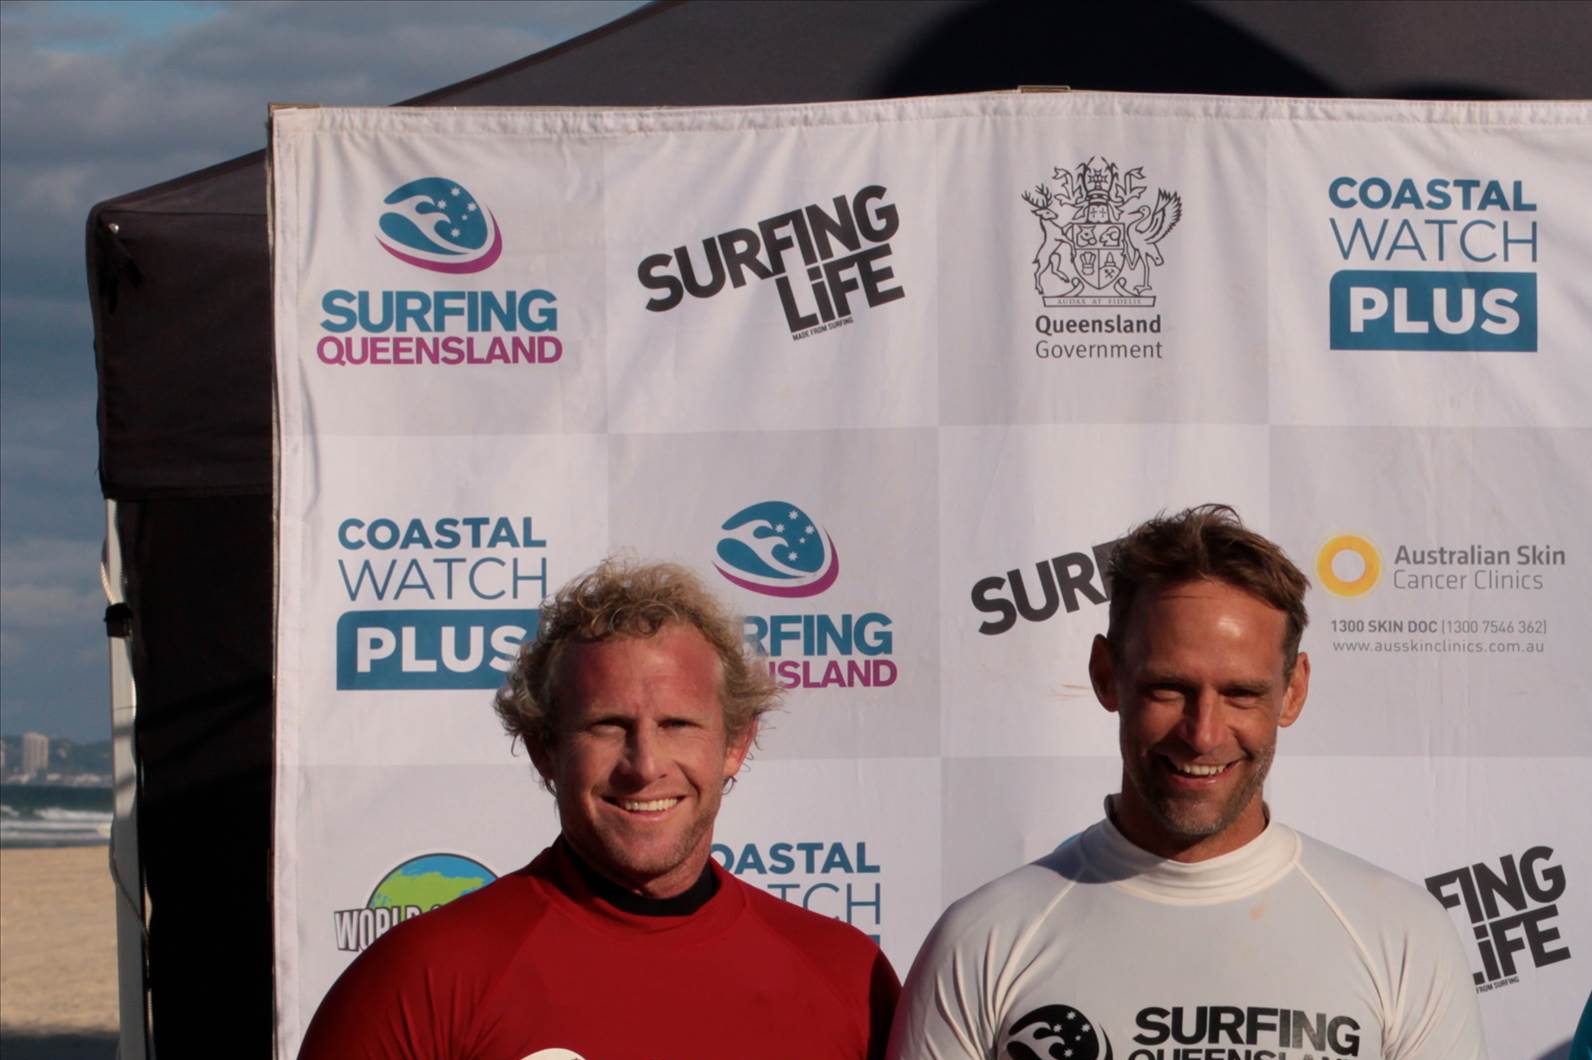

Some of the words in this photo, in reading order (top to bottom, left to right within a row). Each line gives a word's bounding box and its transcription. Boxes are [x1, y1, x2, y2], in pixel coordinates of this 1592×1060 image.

[1329, 177, 1537, 211] COASTAL
[637, 185, 899, 312] SURFING
[1329, 217, 1538, 262] WATCH
[321, 289, 557, 333] SURFING
[1035, 314, 1161, 336] Queensland
[1349, 286, 1520, 335] PLUS
[317, 336, 562, 365] QUEENSLAND
[1035, 340, 1163, 358] Government
[338, 517, 546, 550] COASTAL
[1394, 545, 1511, 565] Australian
[1517, 545, 1566, 566] Skin
[338, 556, 548, 600] WATCH
[1393, 569, 1467, 590] Cancer
[1473, 569, 1543, 590] Clinics
[743, 612, 893, 656] RFING
[1331, 620, 1364, 633] 1300
[1368, 620, 1403, 633] SKIN
[1407, 619, 1438, 633] DOC
[1483, 620, 1514, 633] 7546
[356, 625, 527, 673] PLUS
[1333, 639, 1544, 653] www.ausskinclinics.com.au
[769, 660, 898, 689] SLAND
[711, 842, 880, 875] OASTAL
[1424, 845, 1566, 924] FING
[1132, 1005, 1361, 1057] SURFING
